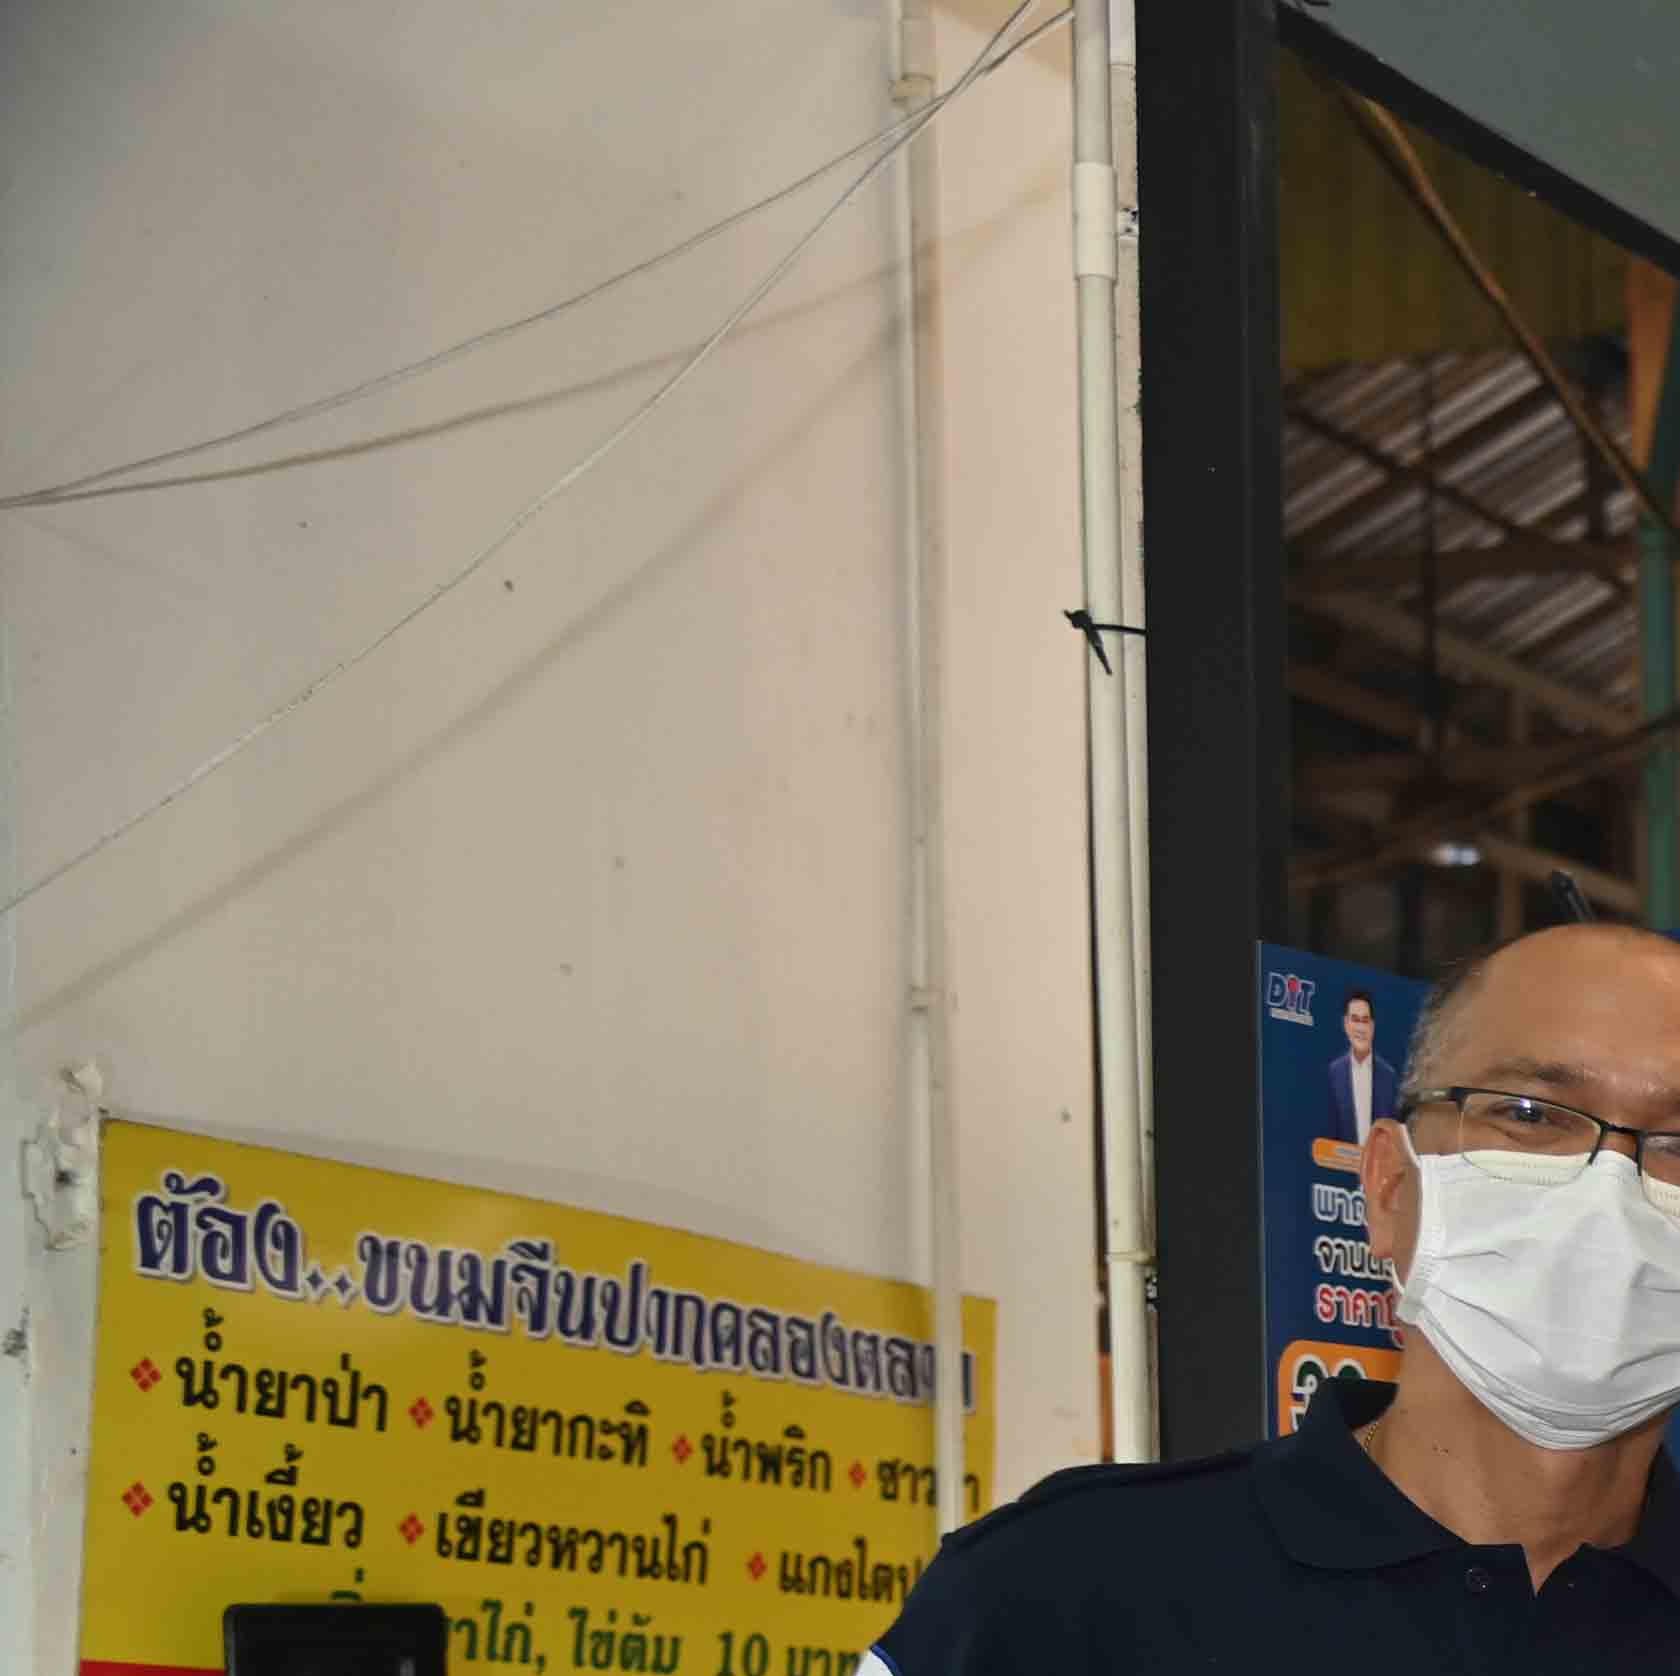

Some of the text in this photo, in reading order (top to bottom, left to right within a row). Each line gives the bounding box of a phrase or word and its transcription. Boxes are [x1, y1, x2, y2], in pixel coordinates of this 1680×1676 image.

[174, 1307, 389, 1433] น้ำยาป่า
[444, 1349, 651, 1468] น้ำยากะทิ
[701, 1391, 832, 1493] น้ำพริก
[167, 1432, 366, 1550] น้ำเงี้ยว
[435, 1488, 710, 1587] เขียวหวานไก่
[567, 1606, 682, 1676] ไข่ต้ม
